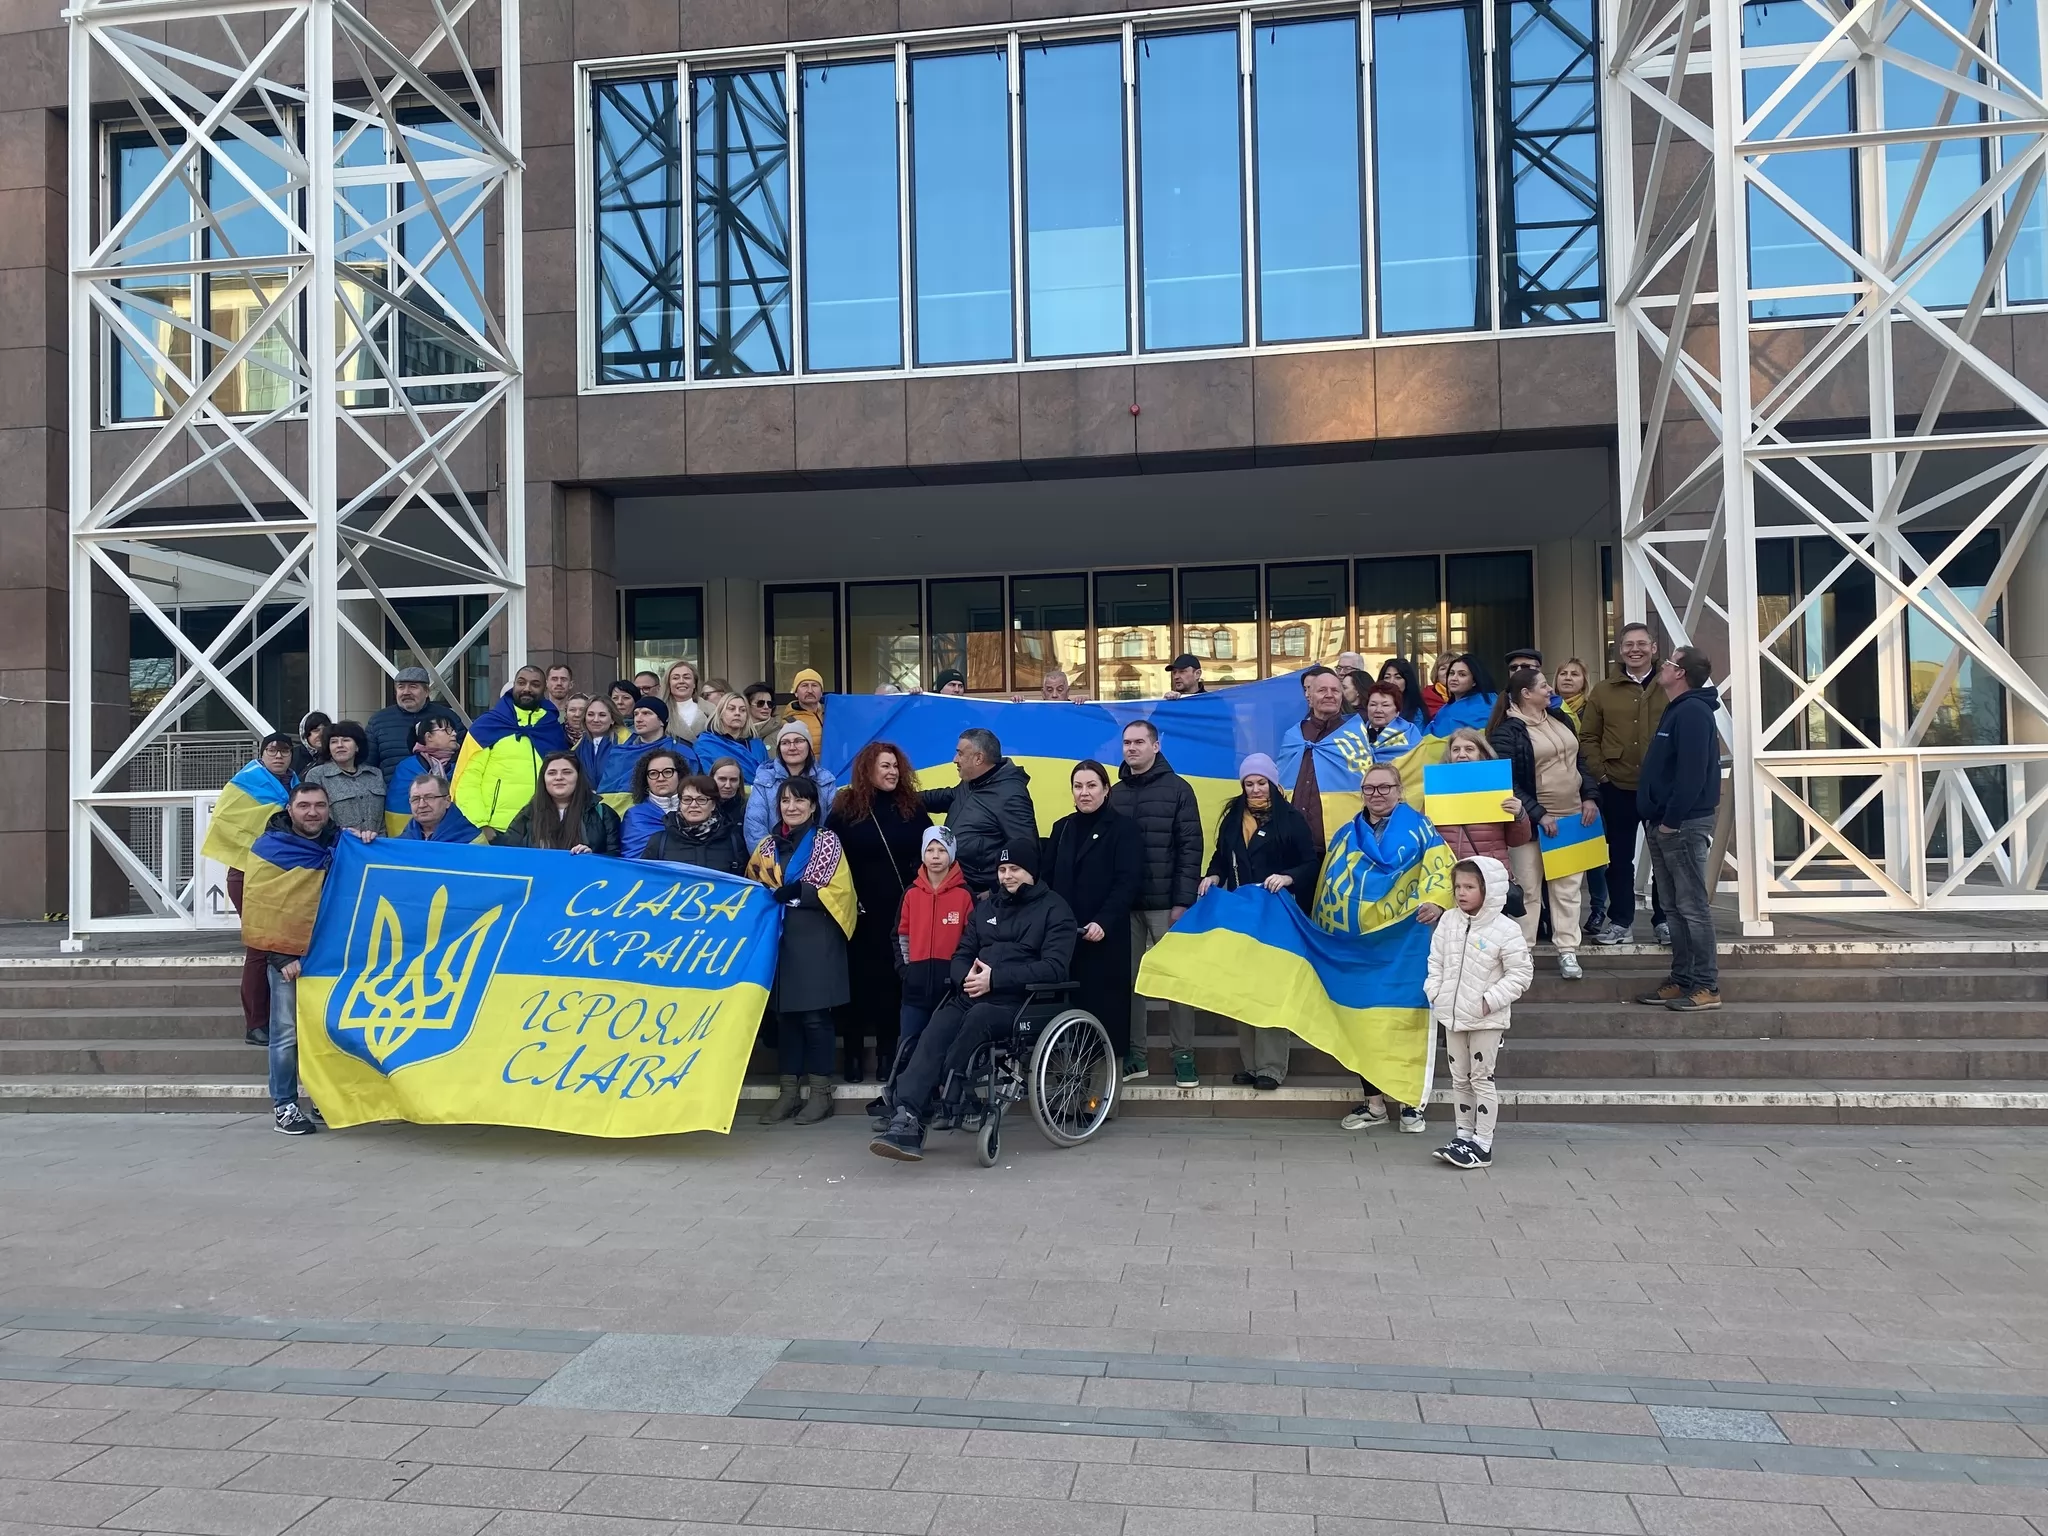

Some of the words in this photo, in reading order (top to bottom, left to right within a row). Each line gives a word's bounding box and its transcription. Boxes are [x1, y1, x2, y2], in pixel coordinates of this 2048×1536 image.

[565, 879, 754, 924] СЛАВА
[542, 927, 748, 976] УКРАЇНІ
[520, 990, 724, 1046] ГЕРОЯМ
[502, 1041, 703, 1100] СЛАВА
